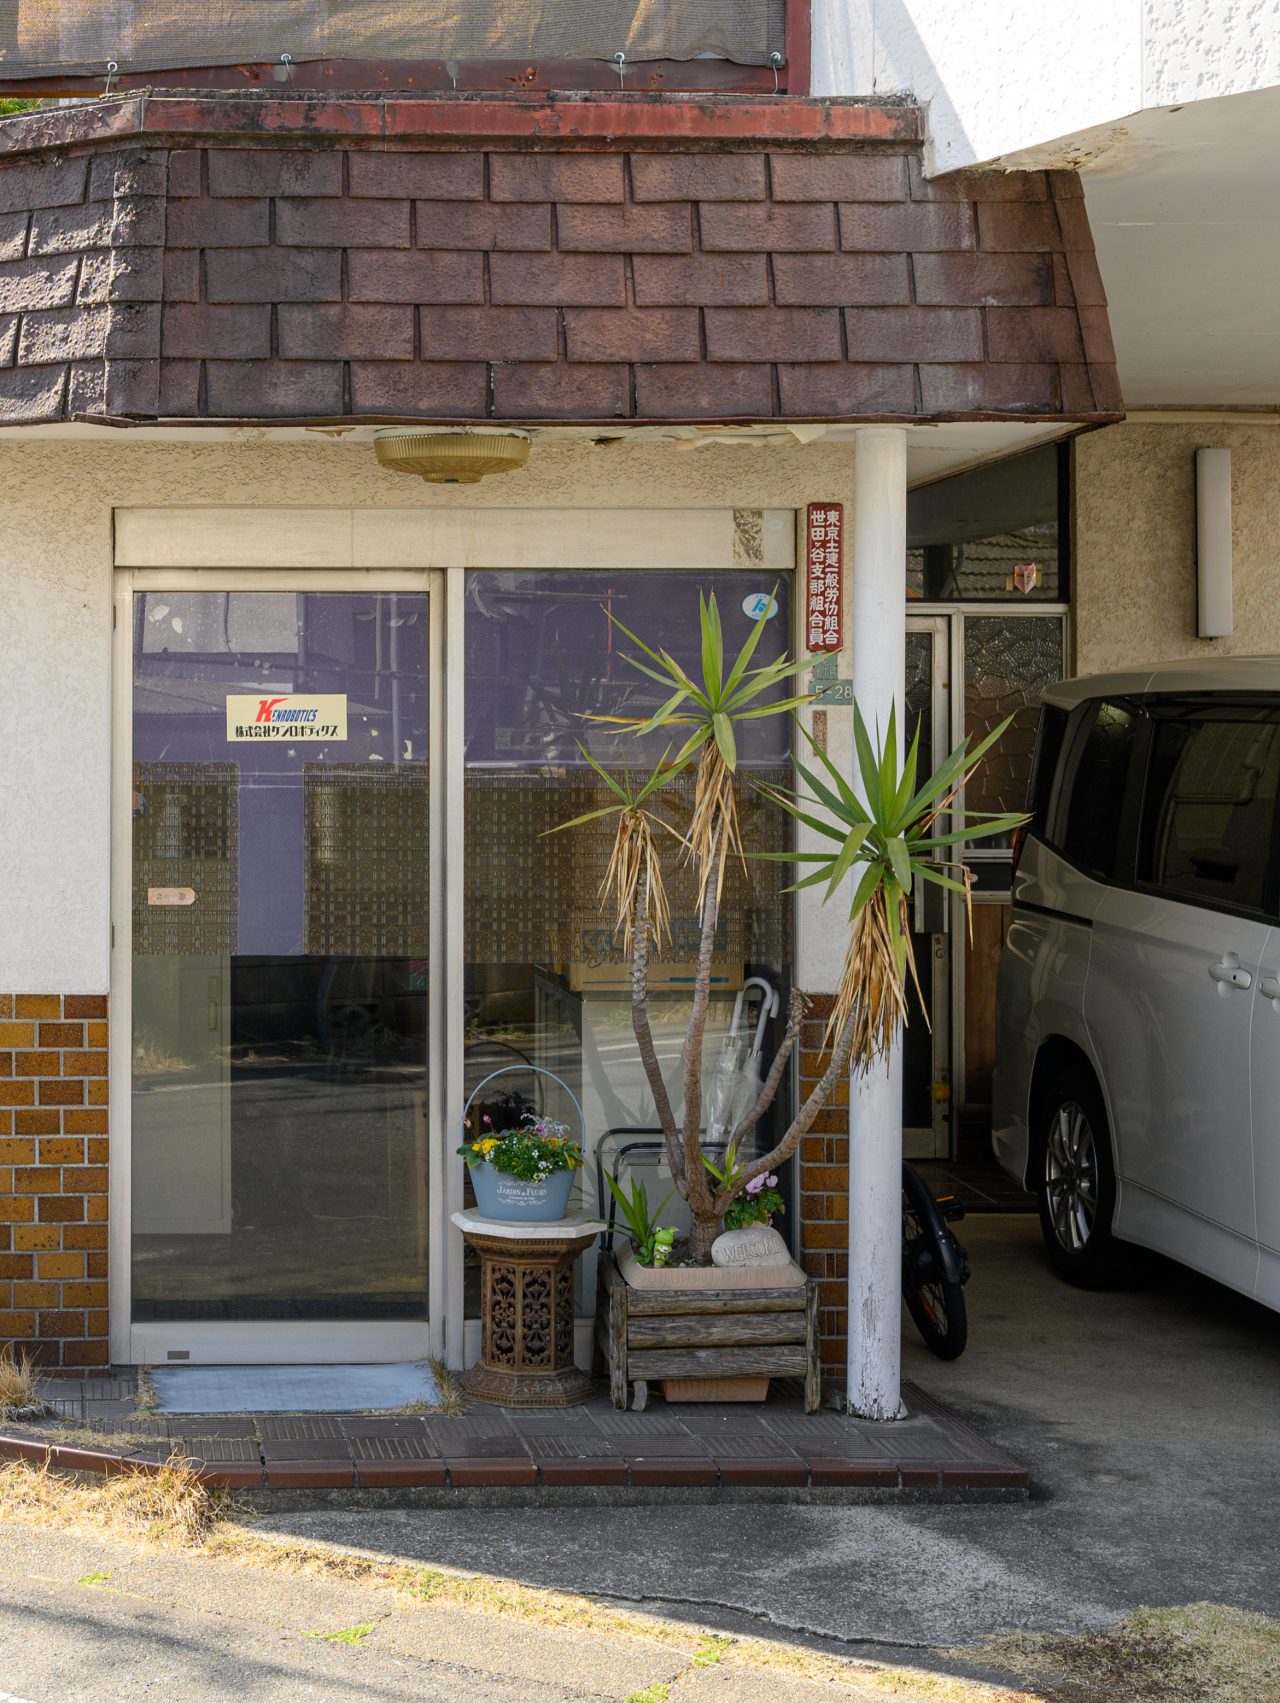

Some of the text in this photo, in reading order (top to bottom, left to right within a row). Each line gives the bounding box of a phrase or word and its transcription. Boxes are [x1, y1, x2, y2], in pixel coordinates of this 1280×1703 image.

[815, 685, 852, 699] 5-28
[235, 725, 338, 738] 株式会社ケンロボティクス
[721, 1239, 783, 1264] WELCOME
